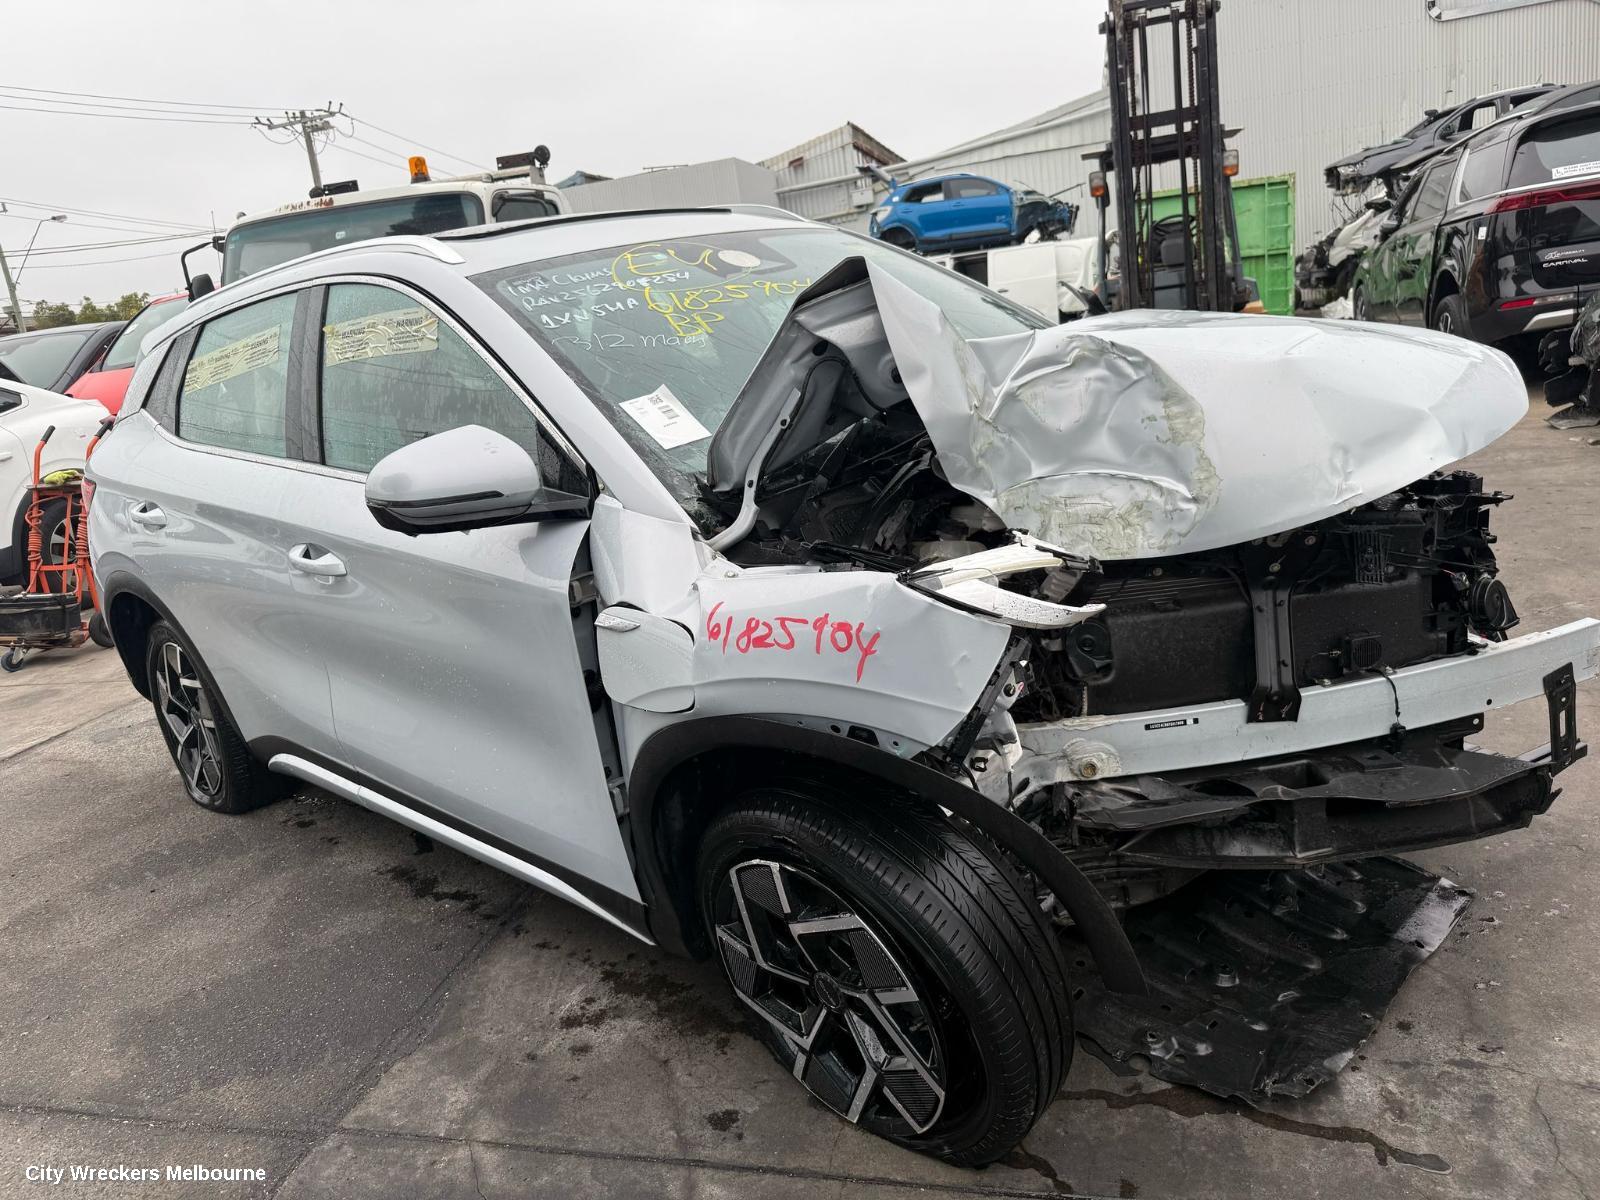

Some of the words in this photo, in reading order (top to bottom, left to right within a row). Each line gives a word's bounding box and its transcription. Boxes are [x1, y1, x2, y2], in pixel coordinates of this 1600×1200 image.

[1543, 257, 1588, 268] CARNIVAL
[663, 311, 725, 337] BP
[706, 601, 881, 684] 61825904
